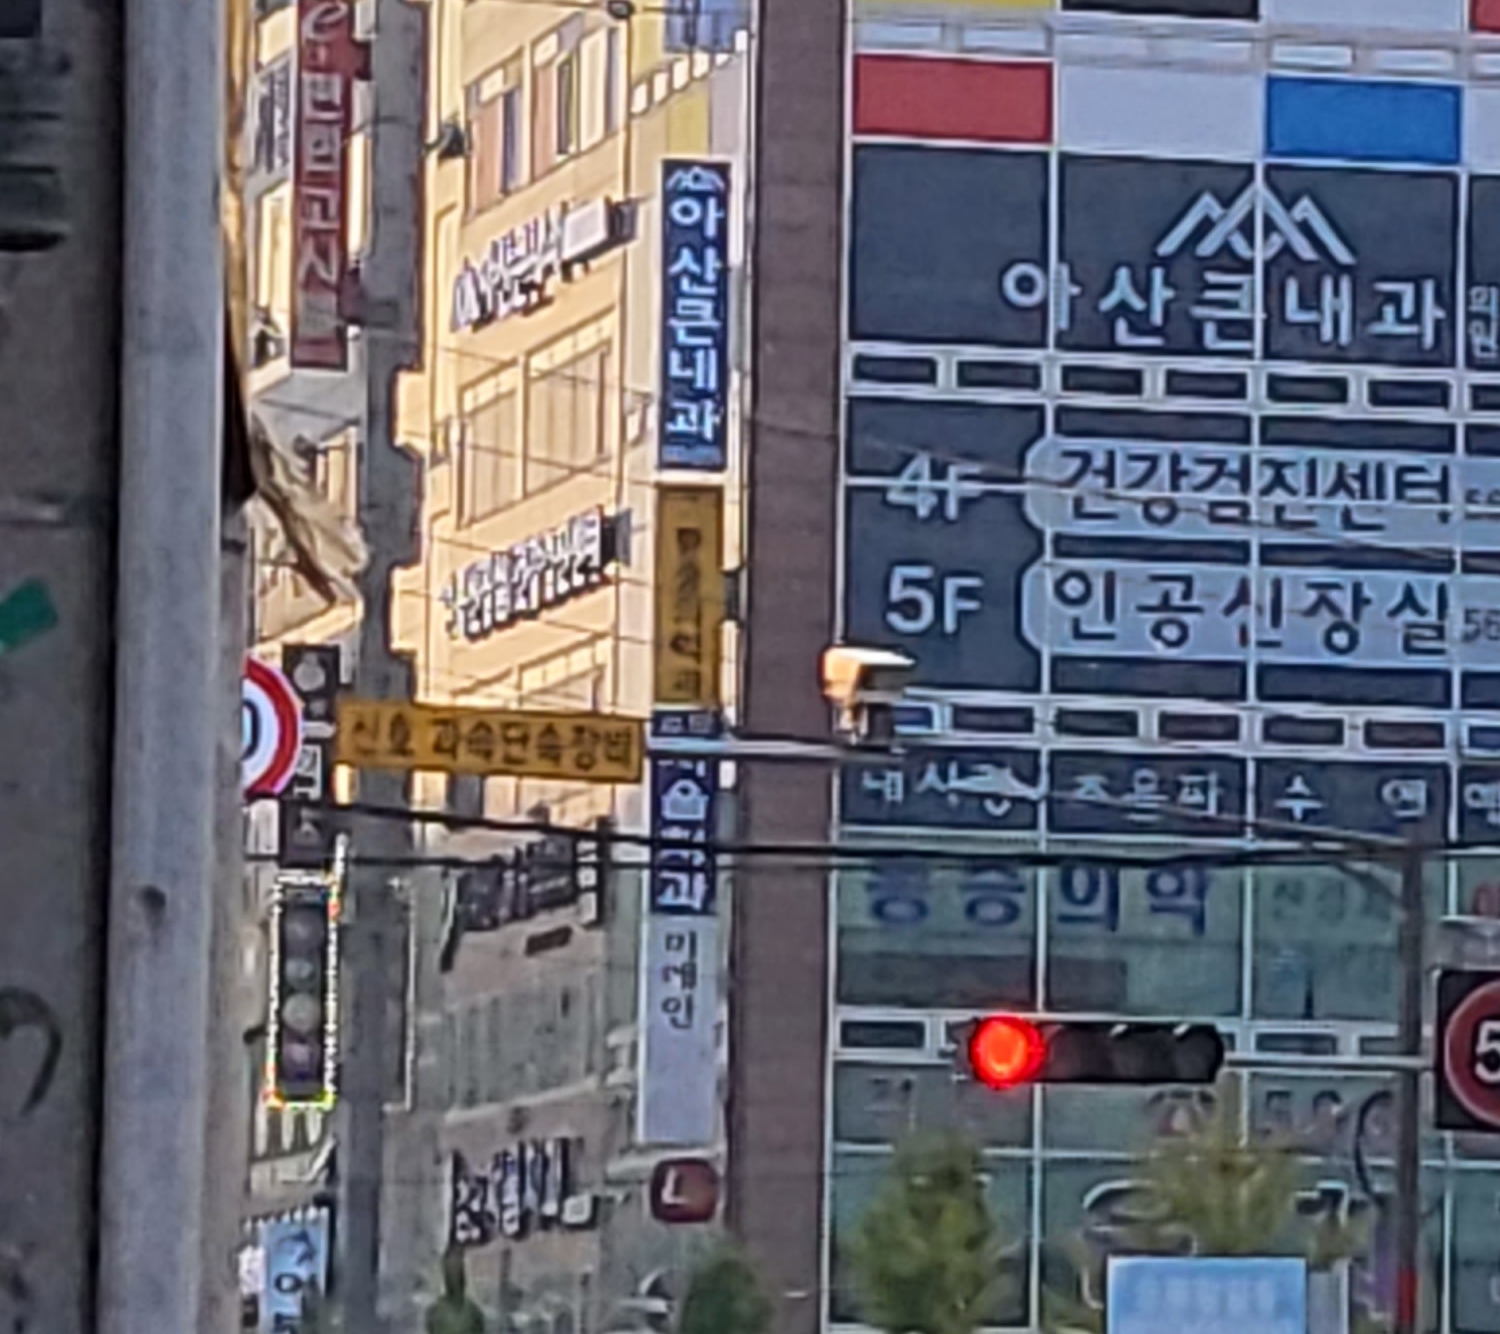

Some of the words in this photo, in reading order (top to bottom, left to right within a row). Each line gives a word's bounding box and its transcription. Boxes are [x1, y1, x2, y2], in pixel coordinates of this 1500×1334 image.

[1002, 261, 1449, 354] 아산큰내과
[1058, 448, 1450, 533] 건강검진센터
[886, 566, 984, 635] 5F
[1053, 570, 1449, 656] 인공신장실
